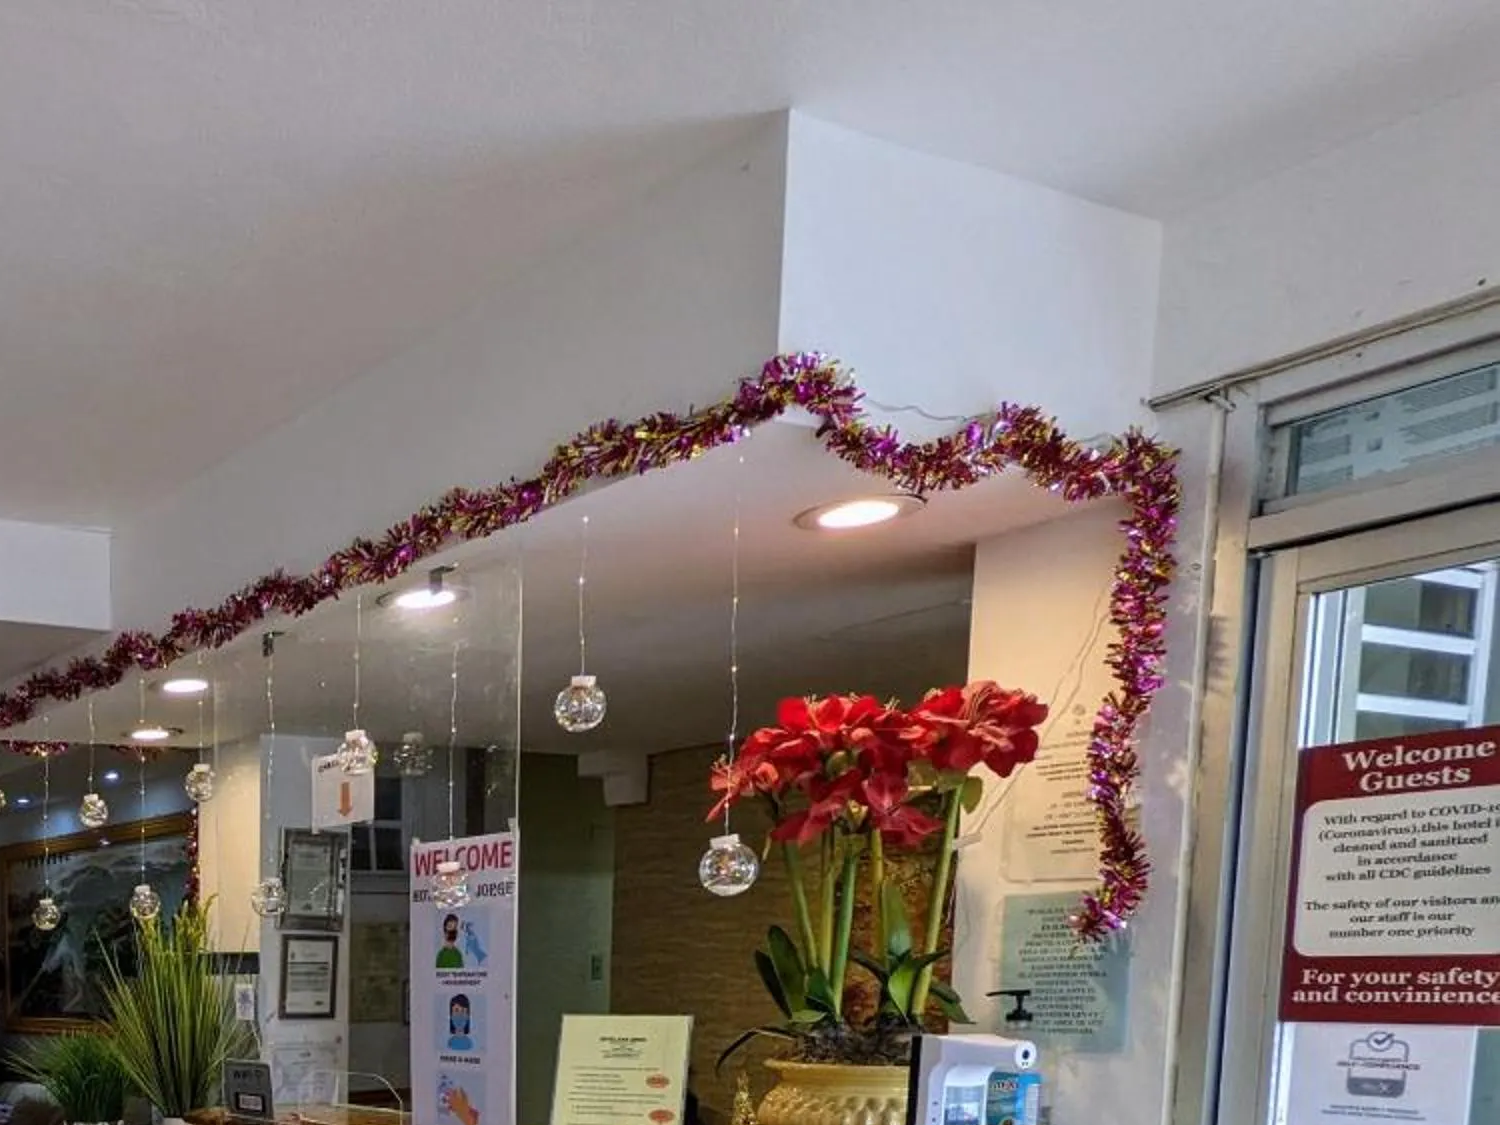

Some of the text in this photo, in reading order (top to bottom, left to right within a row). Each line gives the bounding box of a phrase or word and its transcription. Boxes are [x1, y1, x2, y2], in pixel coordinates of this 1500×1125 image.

[1341, 740, 1496, 772] Welcome
[1359, 766, 1472, 793] Guests
[1324, 813, 1357, 826] With
[1360, 809, 1408, 825] regard
[1411, 808, 1426, 819] to
[1453, 817, 1491, 831] hotel
[1333, 833, 1489, 854] cleaned and sanitized
[1357, 851, 1458, 867] in accordance
[1326, 865, 1492, 881] with all CDC guidelines
[1305, 901, 1330, 911] The
[1332, 899, 1372, 911] safety
[1375, 898, 1390, 909] of
[1392, 899, 1419, 908] our
[1421, 895, 1478, 907] visitors
[1349, 911, 1456, 924] our staff is our
[1329, 925, 1476, 939] number one priority
[1300, 967, 1500, 989] For your safety
[1292, 985, 1500, 1004] and convinience
